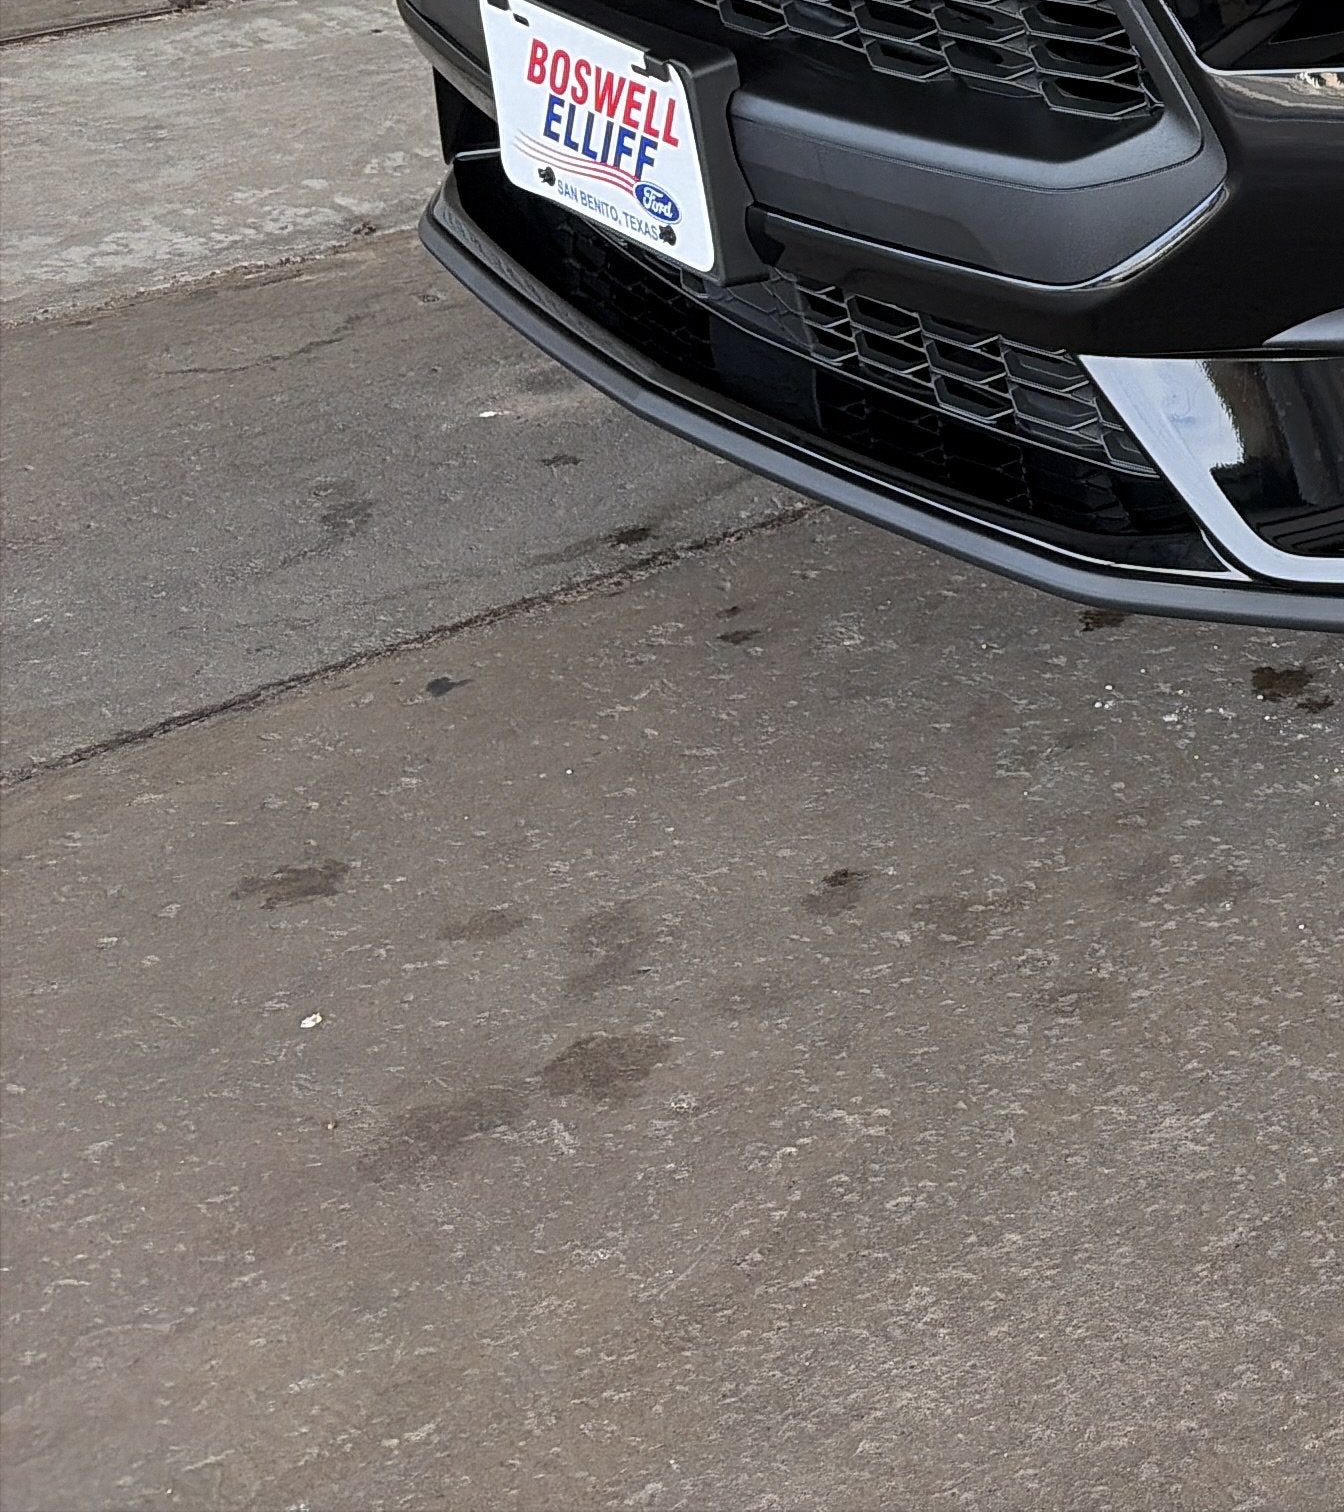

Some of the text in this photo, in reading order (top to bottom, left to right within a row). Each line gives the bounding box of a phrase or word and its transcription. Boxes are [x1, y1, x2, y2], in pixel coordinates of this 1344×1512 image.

[526, 38, 680, 147] BOSWELL
[543, 93, 658, 180] ELLIFF
[557, 179, 579, 203] SAN
[622, 211, 659, 242] TEXAS
[642, 186, 674, 219] Ford
